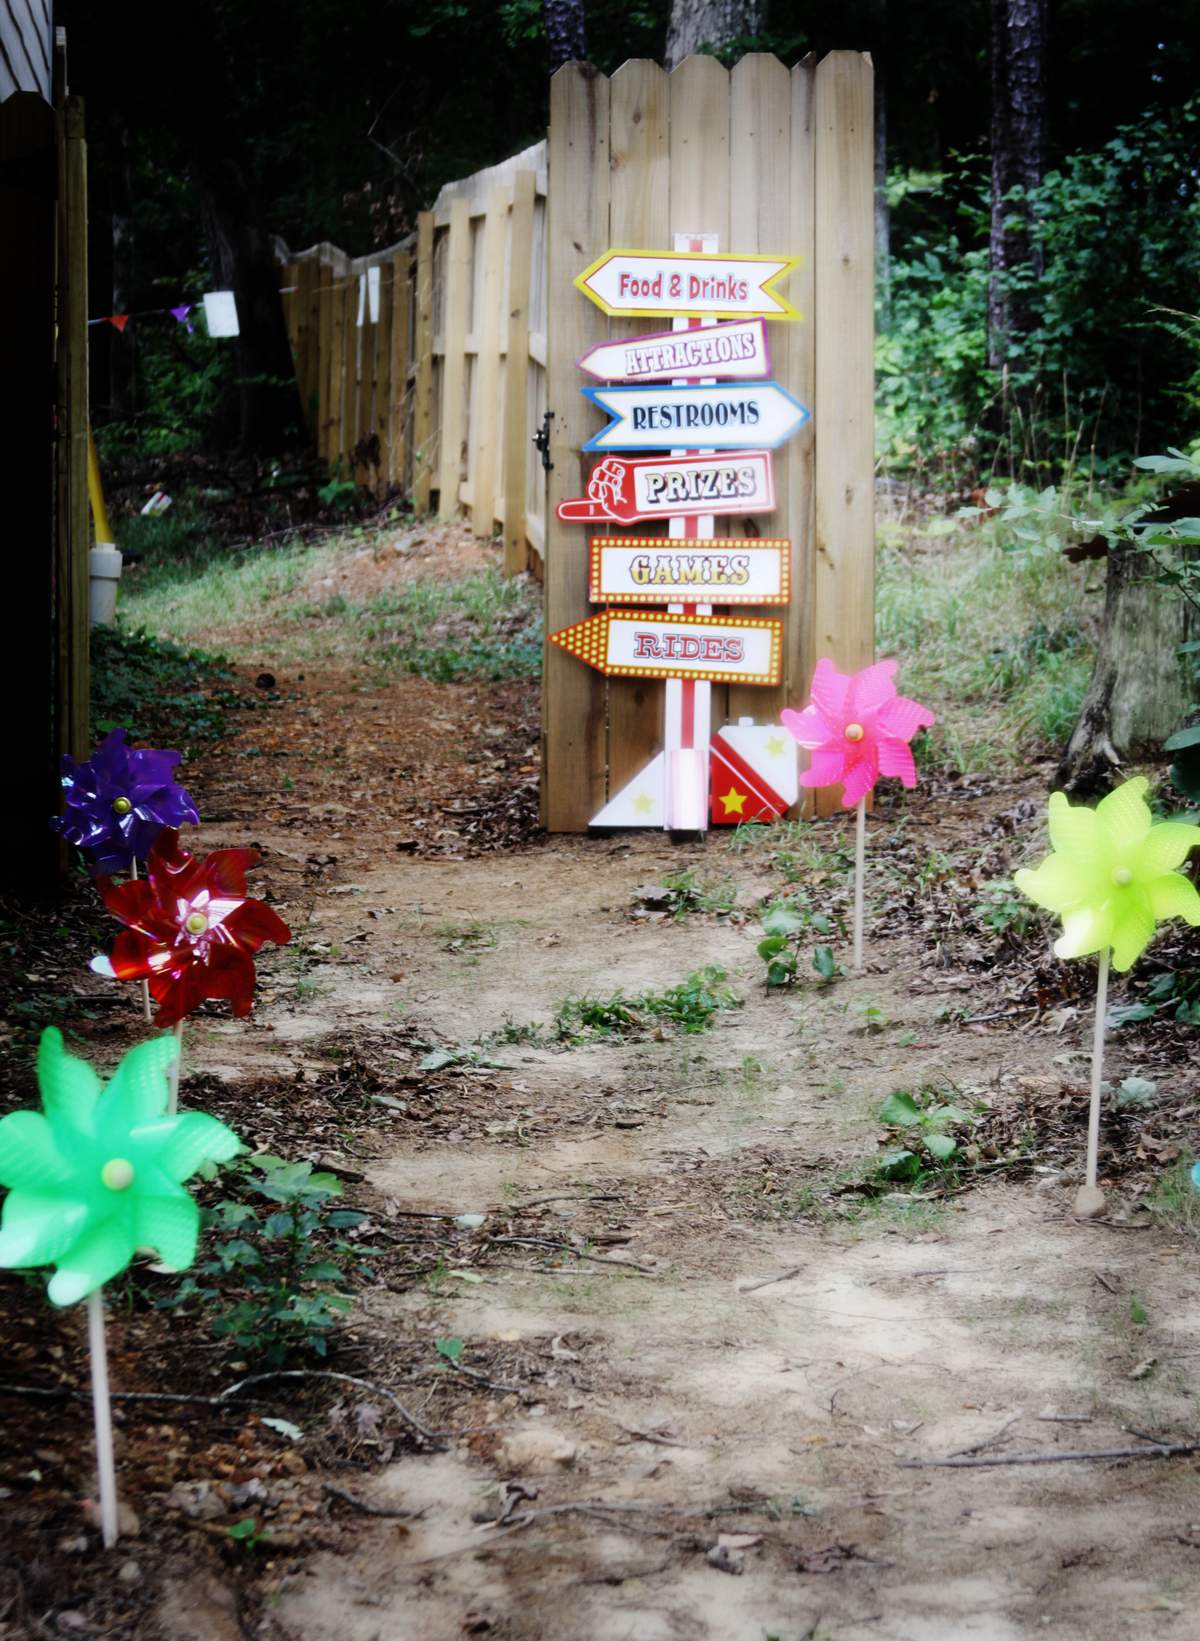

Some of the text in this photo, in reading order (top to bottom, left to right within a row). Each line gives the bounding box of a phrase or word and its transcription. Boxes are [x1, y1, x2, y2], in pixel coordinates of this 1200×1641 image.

[619, 273, 748, 300] Food & Drinks
[625, 333, 756, 376] ATTRACTIONS
[633, 400, 760, 430] RESTROOMS
[645, 467, 756, 504] PRIZES
[629, 554, 750, 585] GAMES
[634, 632, 745, 663] RIDES
